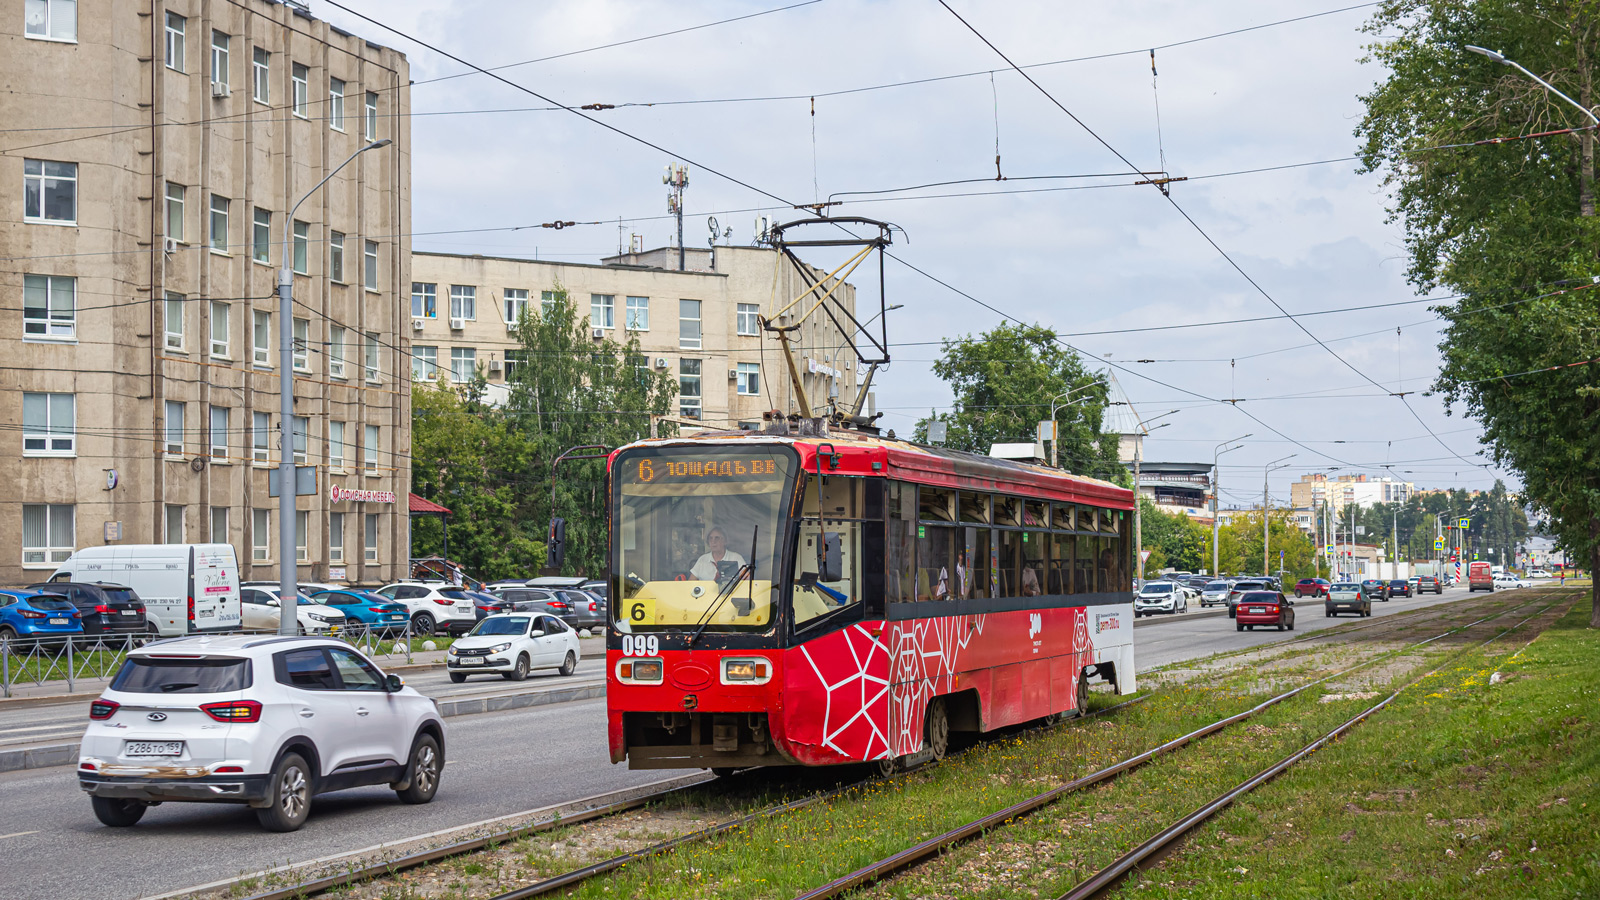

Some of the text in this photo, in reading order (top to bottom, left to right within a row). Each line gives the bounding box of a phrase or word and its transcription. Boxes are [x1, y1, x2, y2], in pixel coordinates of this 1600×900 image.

[639, 459, 654, 482] 6
[340, 489, 396, 503] ОФИСНАЯ МЕБЕЛЬ
[631, 602, 646, 621] 6
[622, 635, 659, 657] 099
[128, 742, 180, 754] Р286ТО 159
